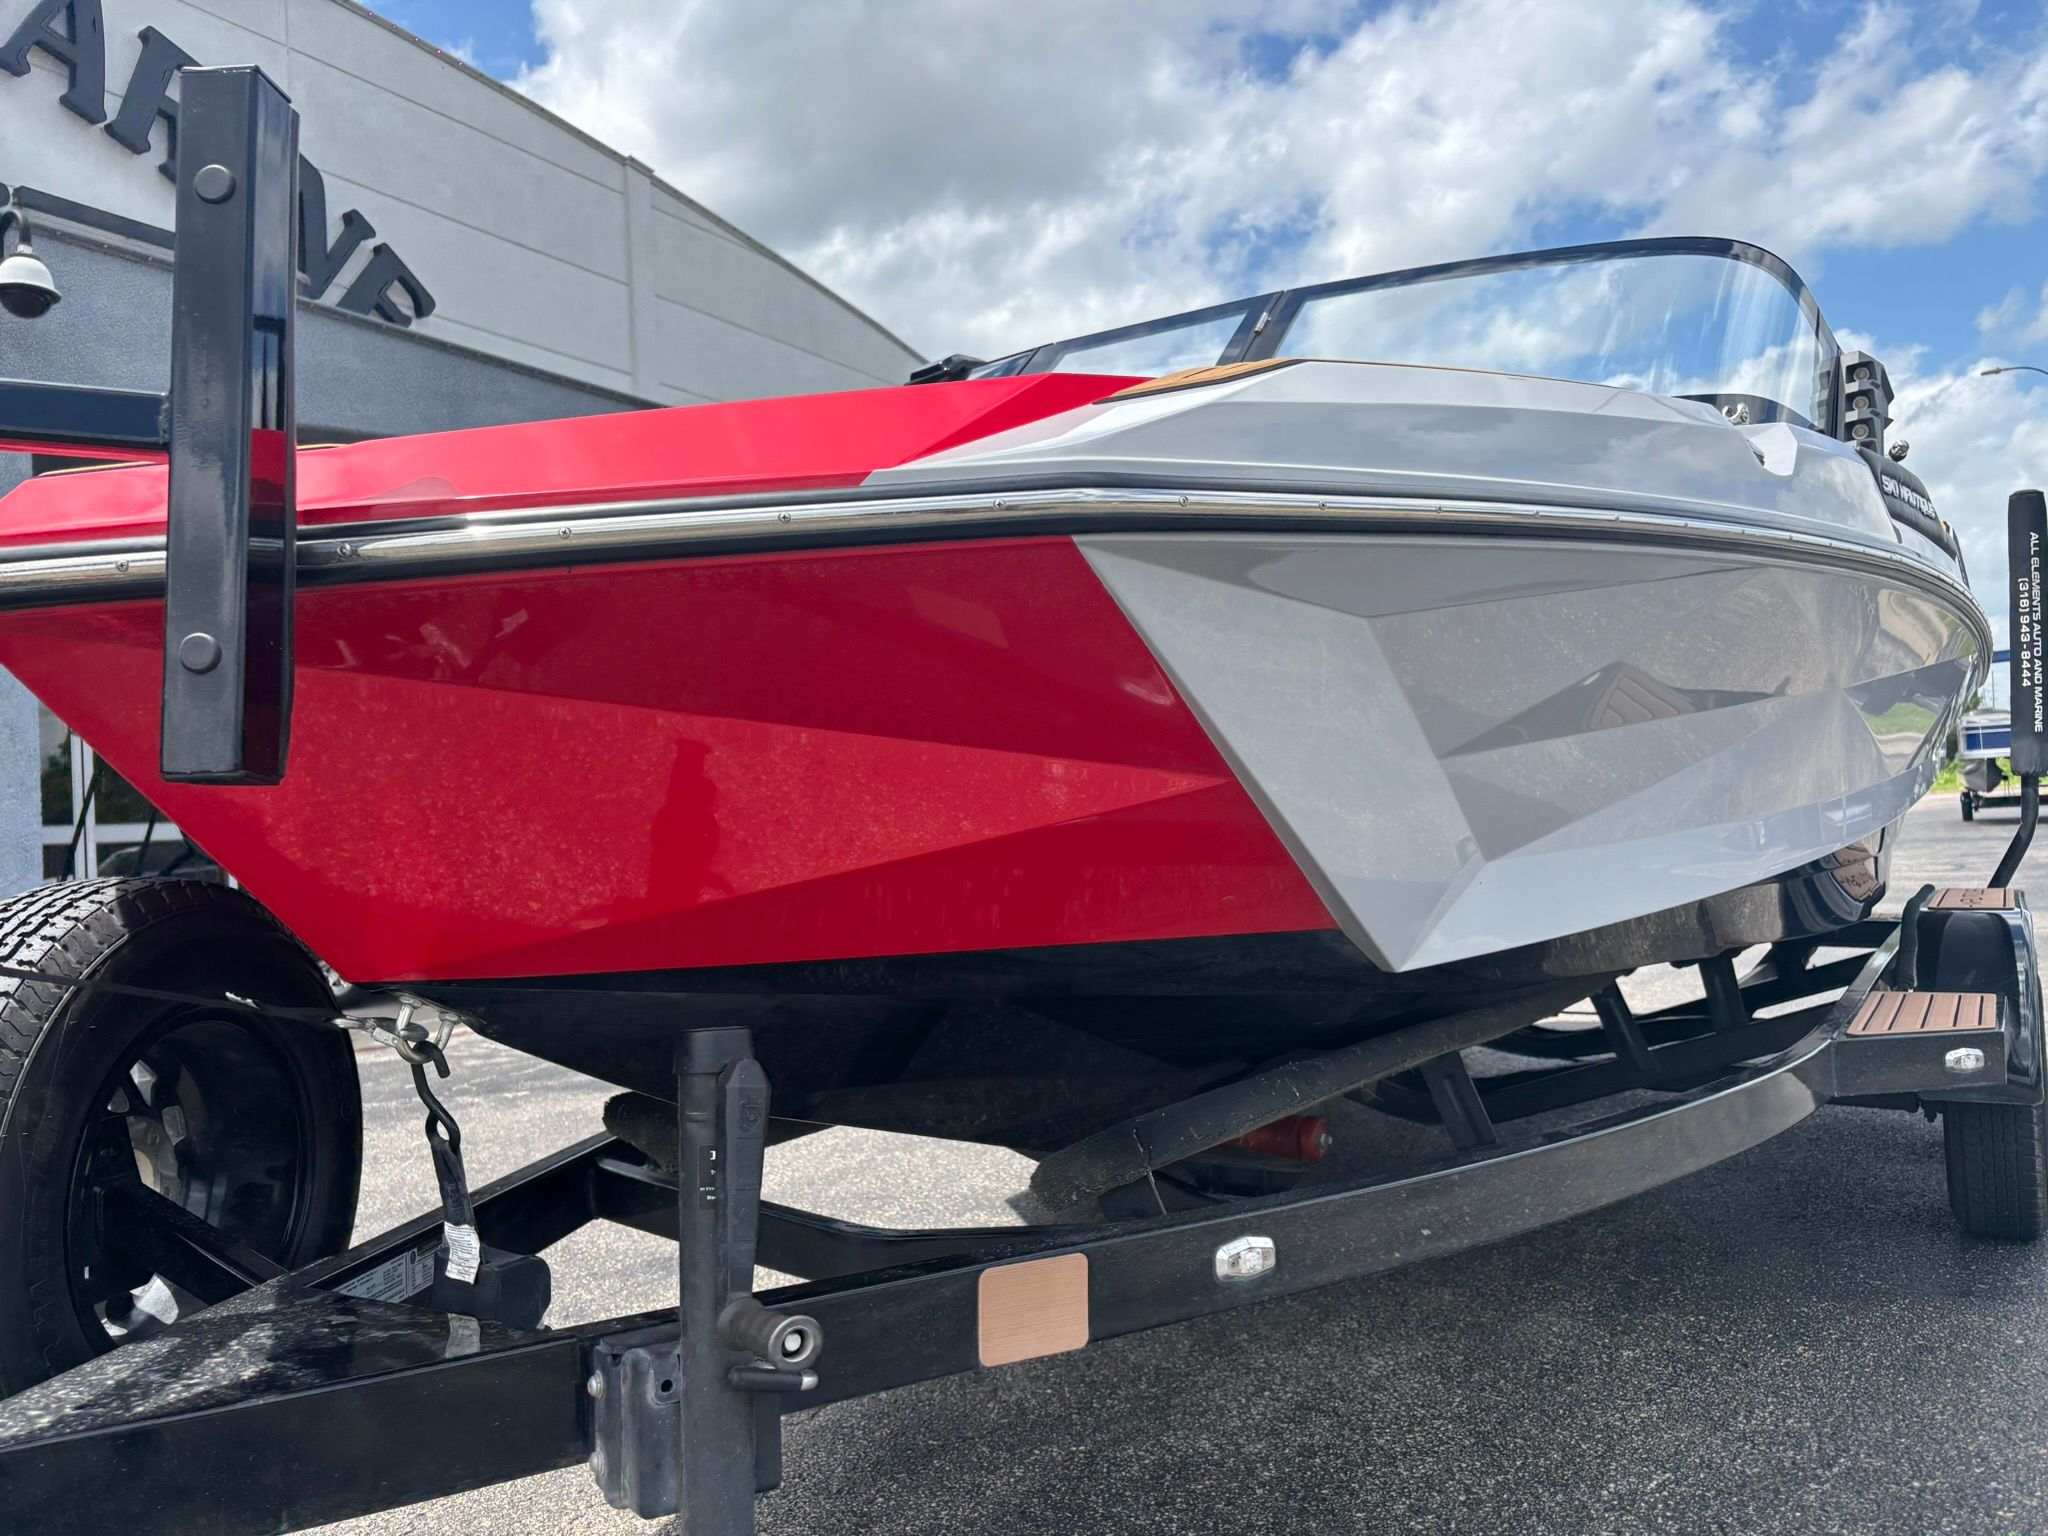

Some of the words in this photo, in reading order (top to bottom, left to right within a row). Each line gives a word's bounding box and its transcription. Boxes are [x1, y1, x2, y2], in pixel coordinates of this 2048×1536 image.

[2029, 532, 2039, 555] ALL
[2031, 557, 2041, 620] ELEMENTS
[2032, 622, 2042, 657] AUTO
[2034, 659, 2043, 684] AND
[2034, 686, 2043, 733] MARINE
